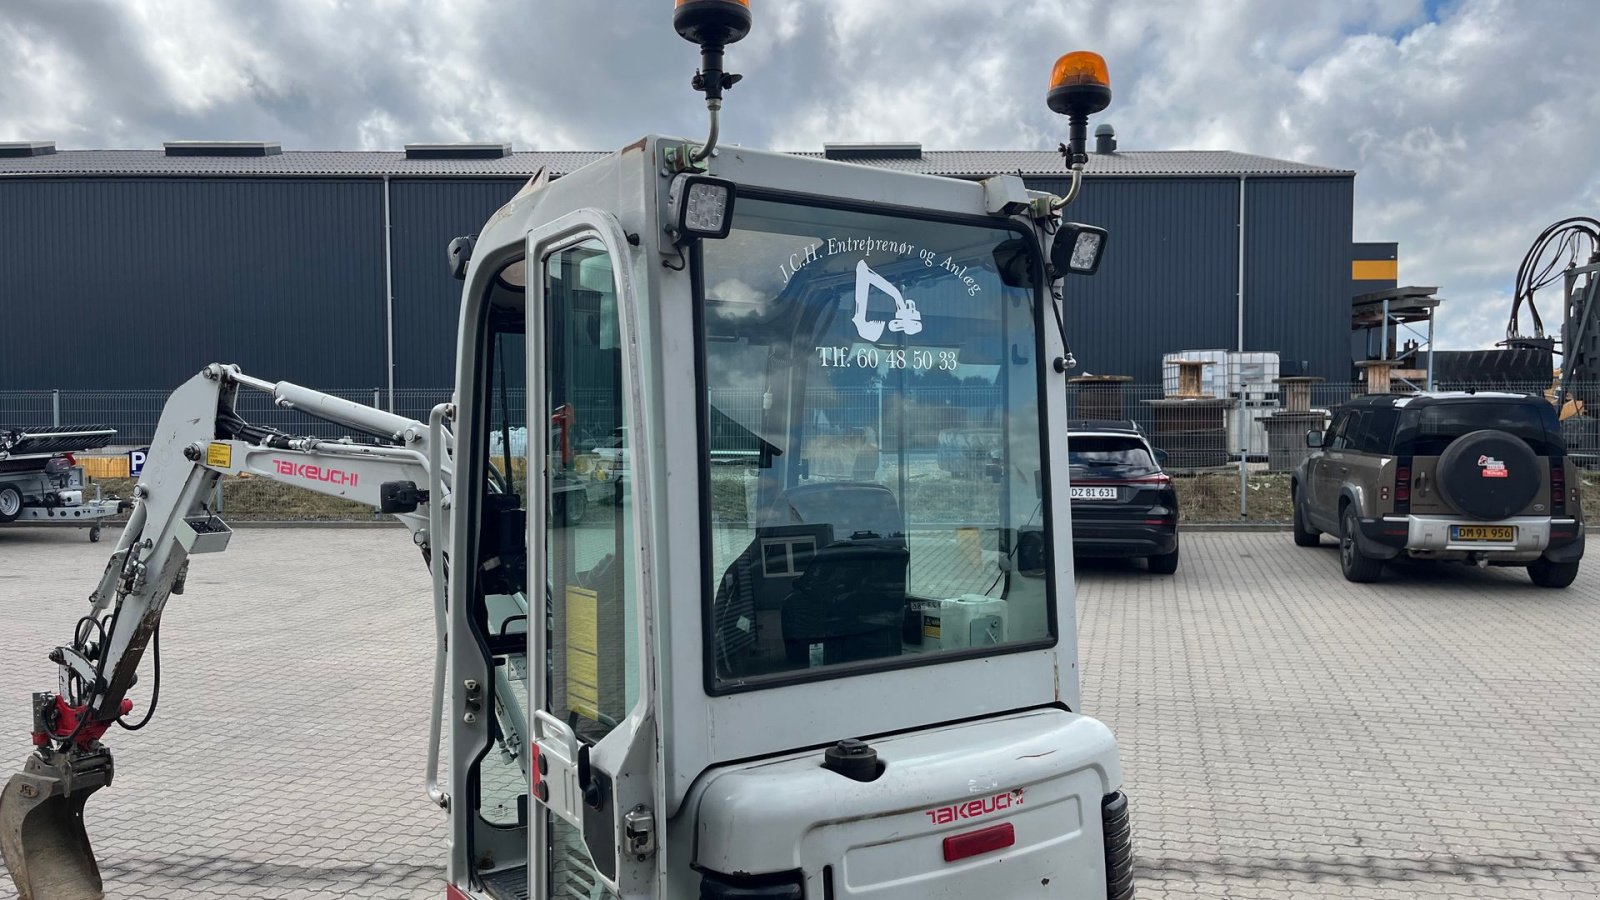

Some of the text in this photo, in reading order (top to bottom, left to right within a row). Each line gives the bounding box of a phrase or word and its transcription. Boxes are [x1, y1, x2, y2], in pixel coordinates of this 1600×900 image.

[778, 236, 982, 297] J.C.H. Entreprenør og Anlæg
[815, 346, 957, 371] Tlf. 60 48 50 33
[131, 451, 146, 471] P
[1071, 488, 1115, 497] DZ 81 631
[1459, 528, 1511, 538] DM 91 956
